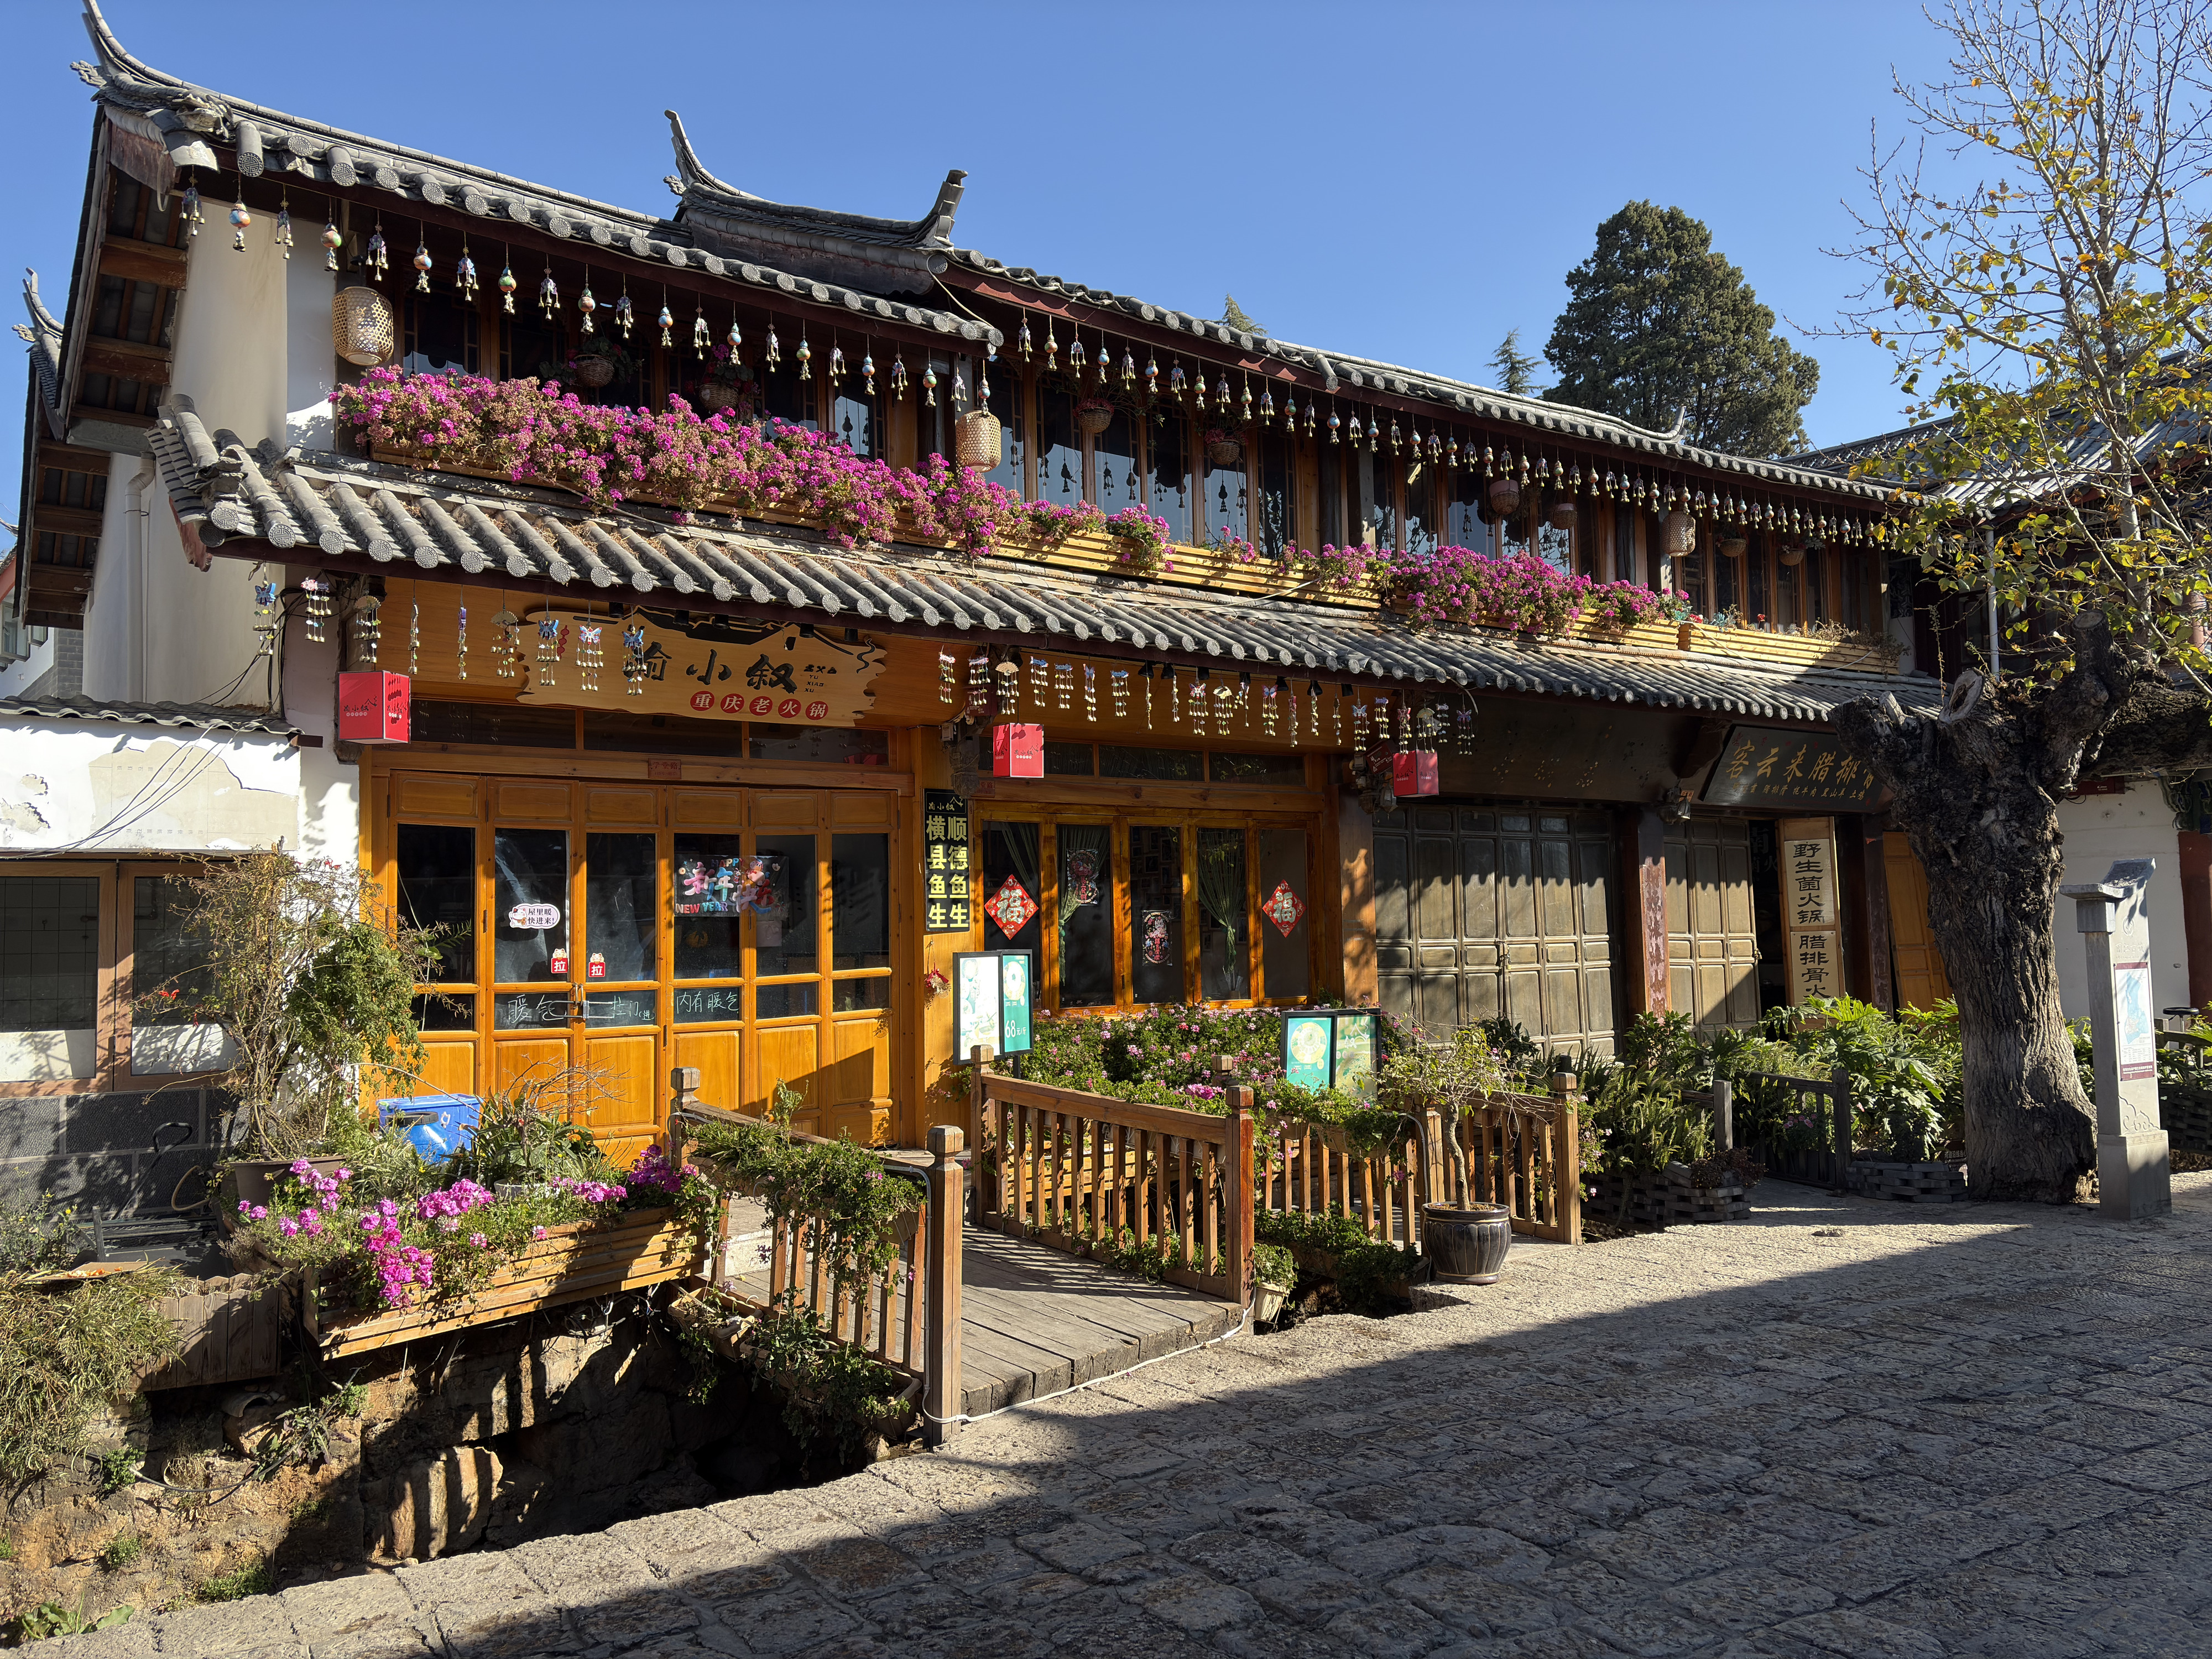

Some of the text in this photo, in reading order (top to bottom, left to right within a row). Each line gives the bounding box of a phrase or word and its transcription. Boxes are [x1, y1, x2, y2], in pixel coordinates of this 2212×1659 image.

[693, 692, 827, 718] 重庆老火锅
[711, 858, 744, 867] HAPPY
[926, 815, 947, 928] 横县鱼生
[947, 816, 969, 928] 顺德鱼生
[1793, 843, 1825, 924] 野生菌火锅
[675, 901, 728, 914] NEW YEAR
[997, 888, 1025, 924] 福
[1272, 891, 1297, 923] 福
[554, 961, 566, 972] 拉
[591, 965, 603, 976] 拉
[676, 990, 740, 1014] 内有暖气
